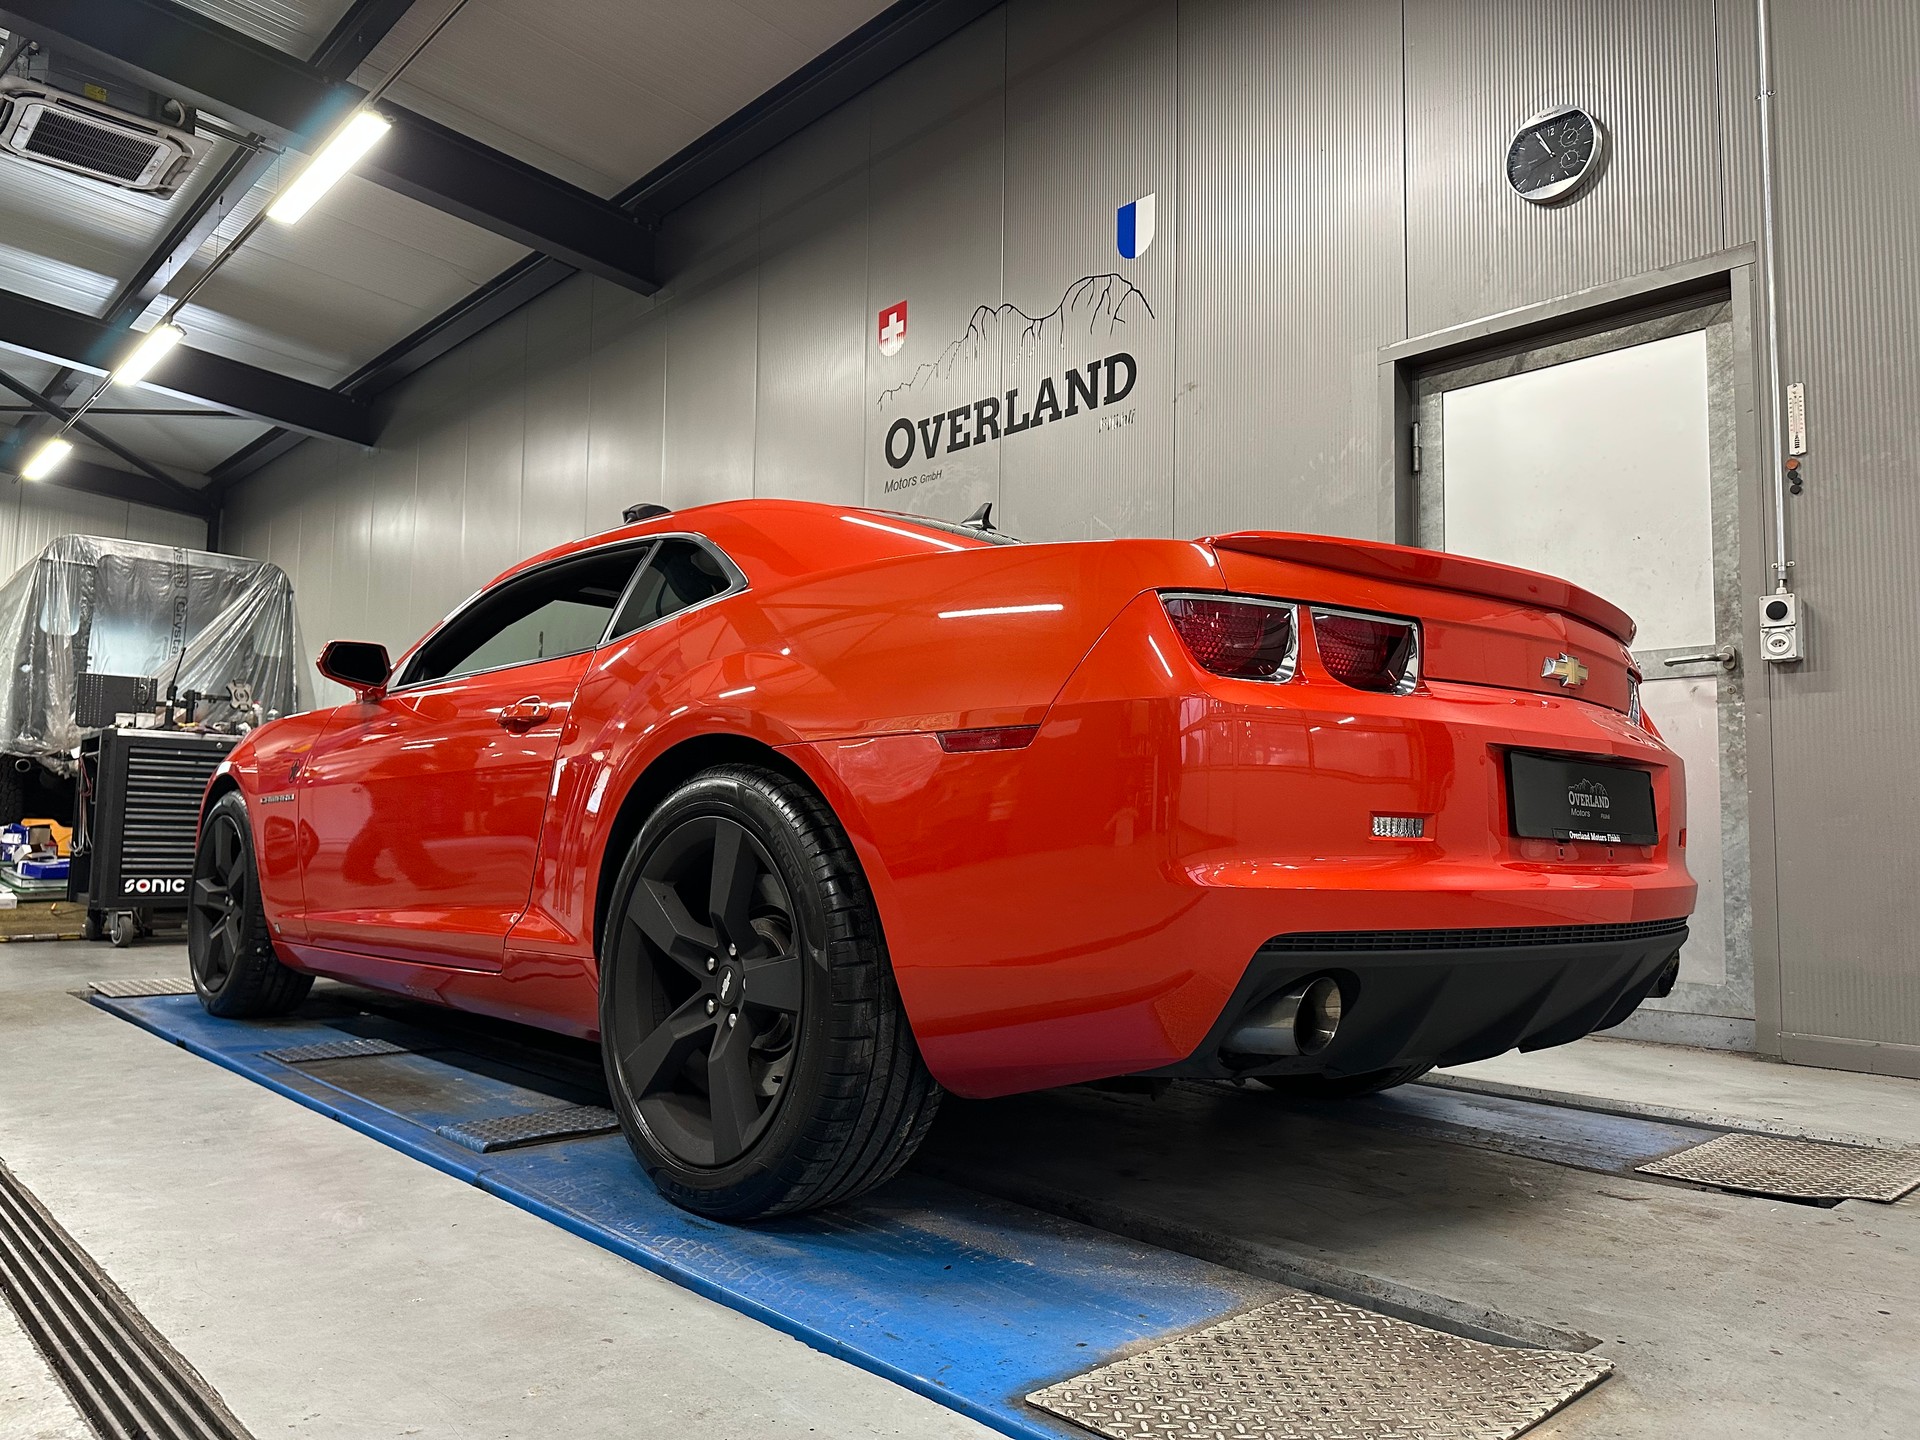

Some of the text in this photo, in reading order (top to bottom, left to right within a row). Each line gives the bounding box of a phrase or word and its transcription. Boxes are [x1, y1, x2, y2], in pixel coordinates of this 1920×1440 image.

[1547, 127, 1555, 137] 12
[1550, 173, 1555, 182] 6
[885, 352, 1137, 469] OVERLAND
[884, 469, 943, 494] Motors GmbH
[172, 602, 186, 655] Crysta
[1568, 790, 1610, 809] OVERLAND
[1570, 808, 1591, 817] Motors
[1568, 830, 1590, 841] Overland
[1590, 832, 1607, 842] Motors
